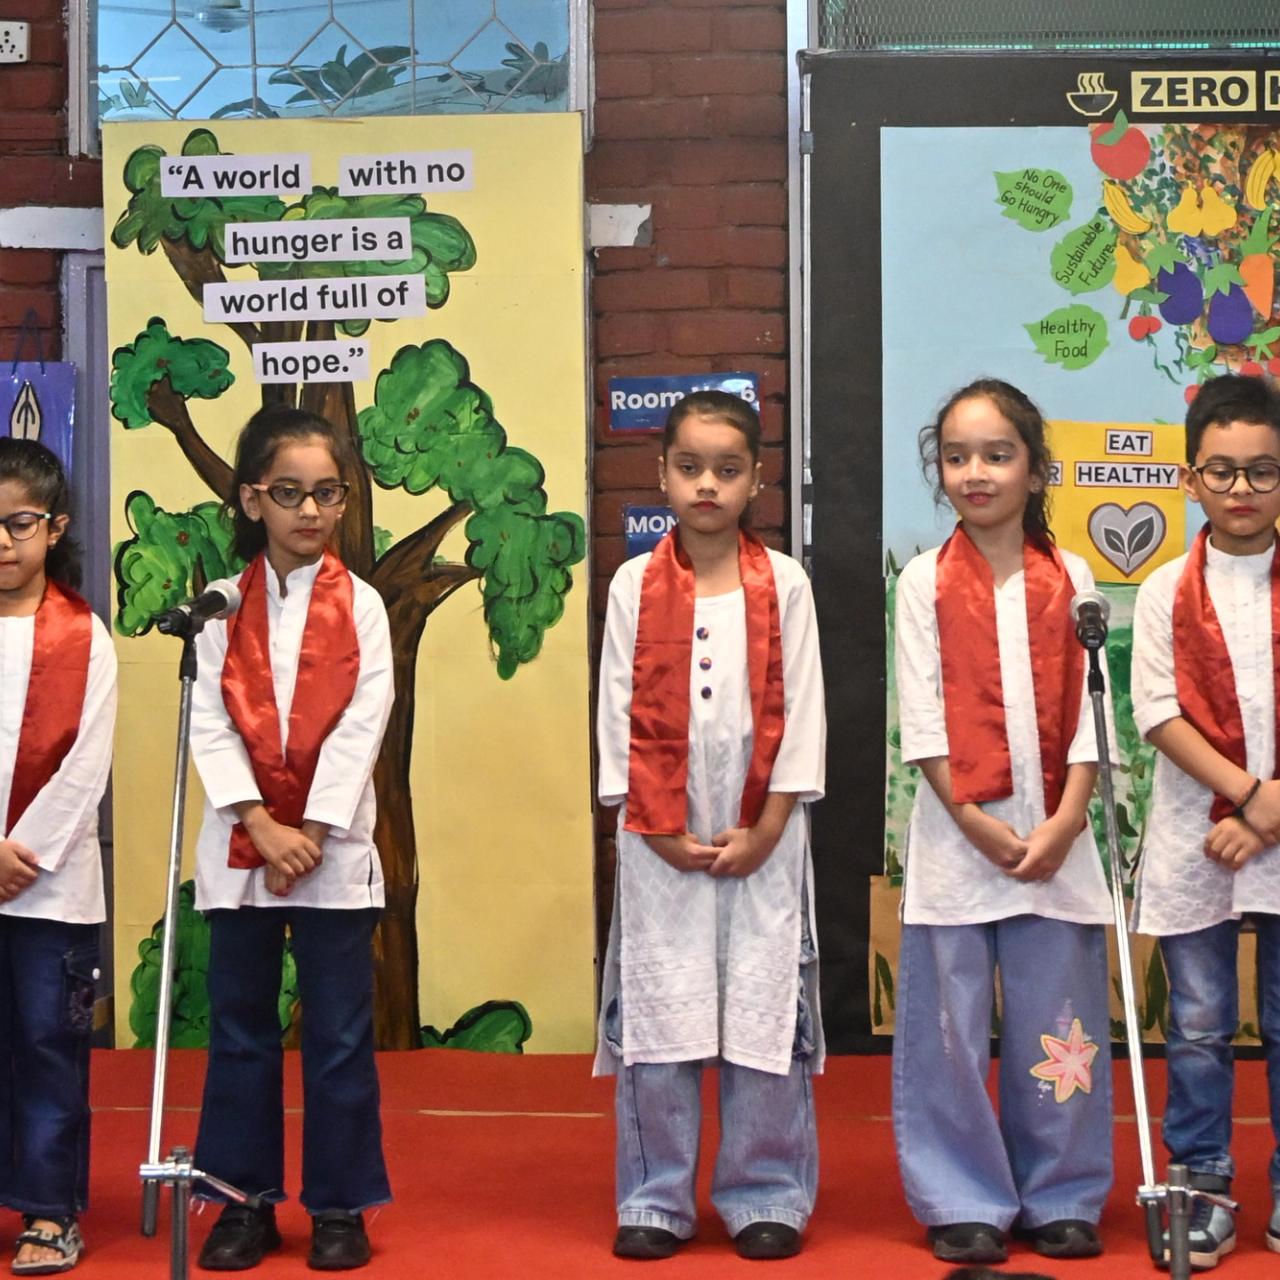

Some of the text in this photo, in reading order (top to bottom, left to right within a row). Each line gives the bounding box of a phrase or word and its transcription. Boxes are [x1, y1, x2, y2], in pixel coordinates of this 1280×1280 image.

[1139, 75, 1251, 107] ZERO
[213, 164, 301, 189] world
[348, 160, 417, 187] with
[426, 162, 466, 184] no
[1022, 169, 1068, 193] No One
[1001, 190, 1060, 228] Go Hungry
[232, 226, 404, 260] hunger is a
[1078, 244, 1115, 286] Future
[220, 281, 409, 314] world full of
[1040, 318, 1096, 338] Healthy
[1054, 340, 1088, 358] Food
[261, 347, 364, 381] hope.”
[611, 390, 685, 411] Room
[1109, 434, 1149, 452] EAT
[1077, 466, 1176, 484] HEALTHY
